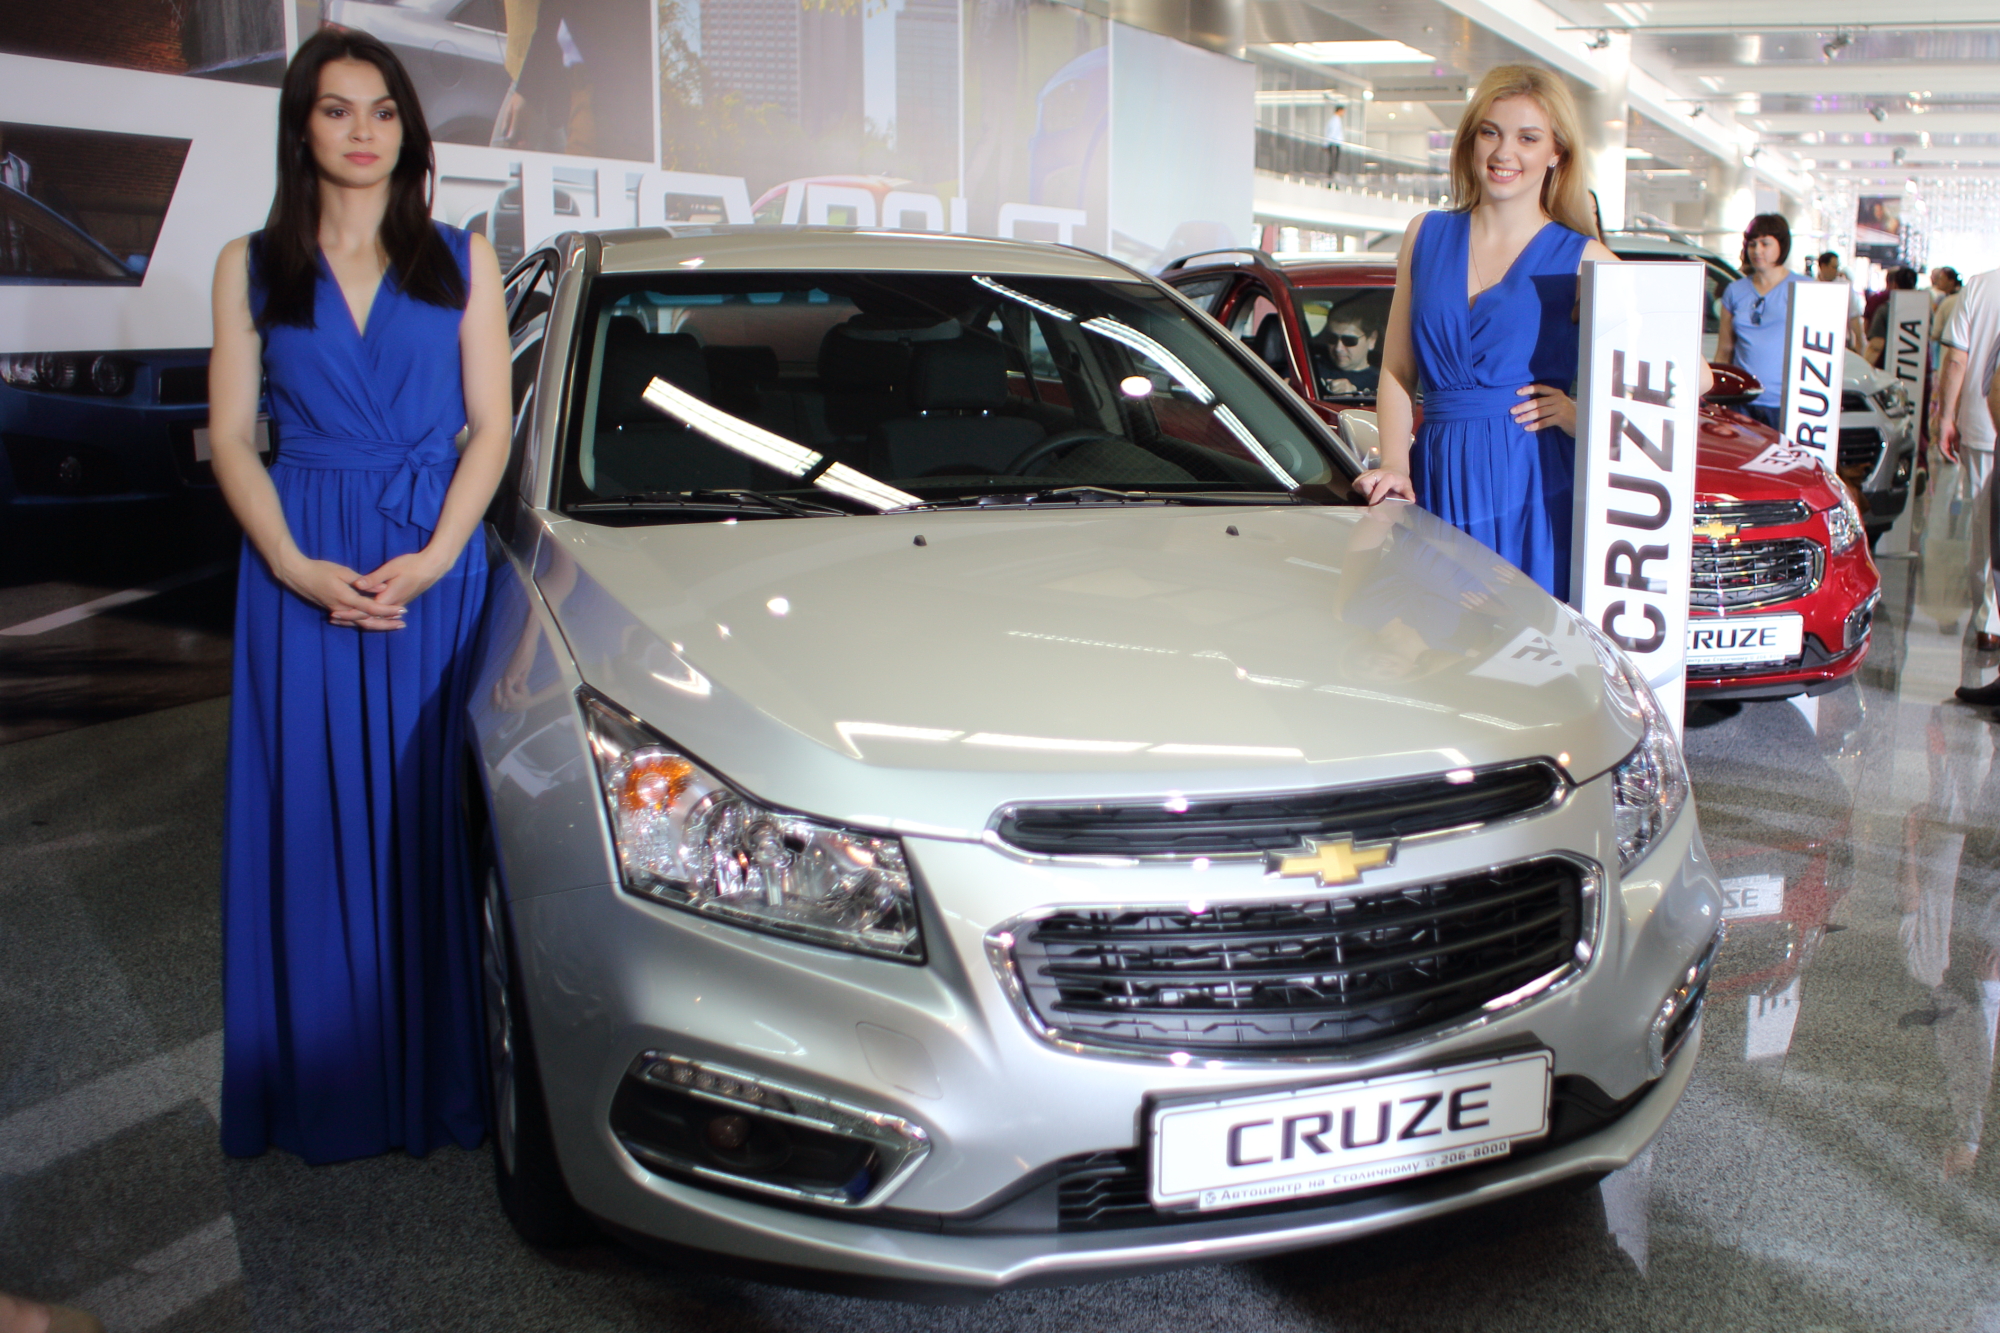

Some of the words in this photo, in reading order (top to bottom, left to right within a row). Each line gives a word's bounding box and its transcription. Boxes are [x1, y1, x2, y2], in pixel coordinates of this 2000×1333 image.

[1790, 325, 1834, 462] RUZE
[1896, 320, 1922, 415] TIVA
[1601, 349, 1676, 654] CRUZE
[1221, 1183, 1302, 1201] Автоцентр
[1308, 1178, 1326, 1189] на
[1333, 1161, 1421, 1185] Столичному
[1440, 1142, 1508, 1165] 206-8000
[1226, 1082, 1492, 1168] CRUZE
